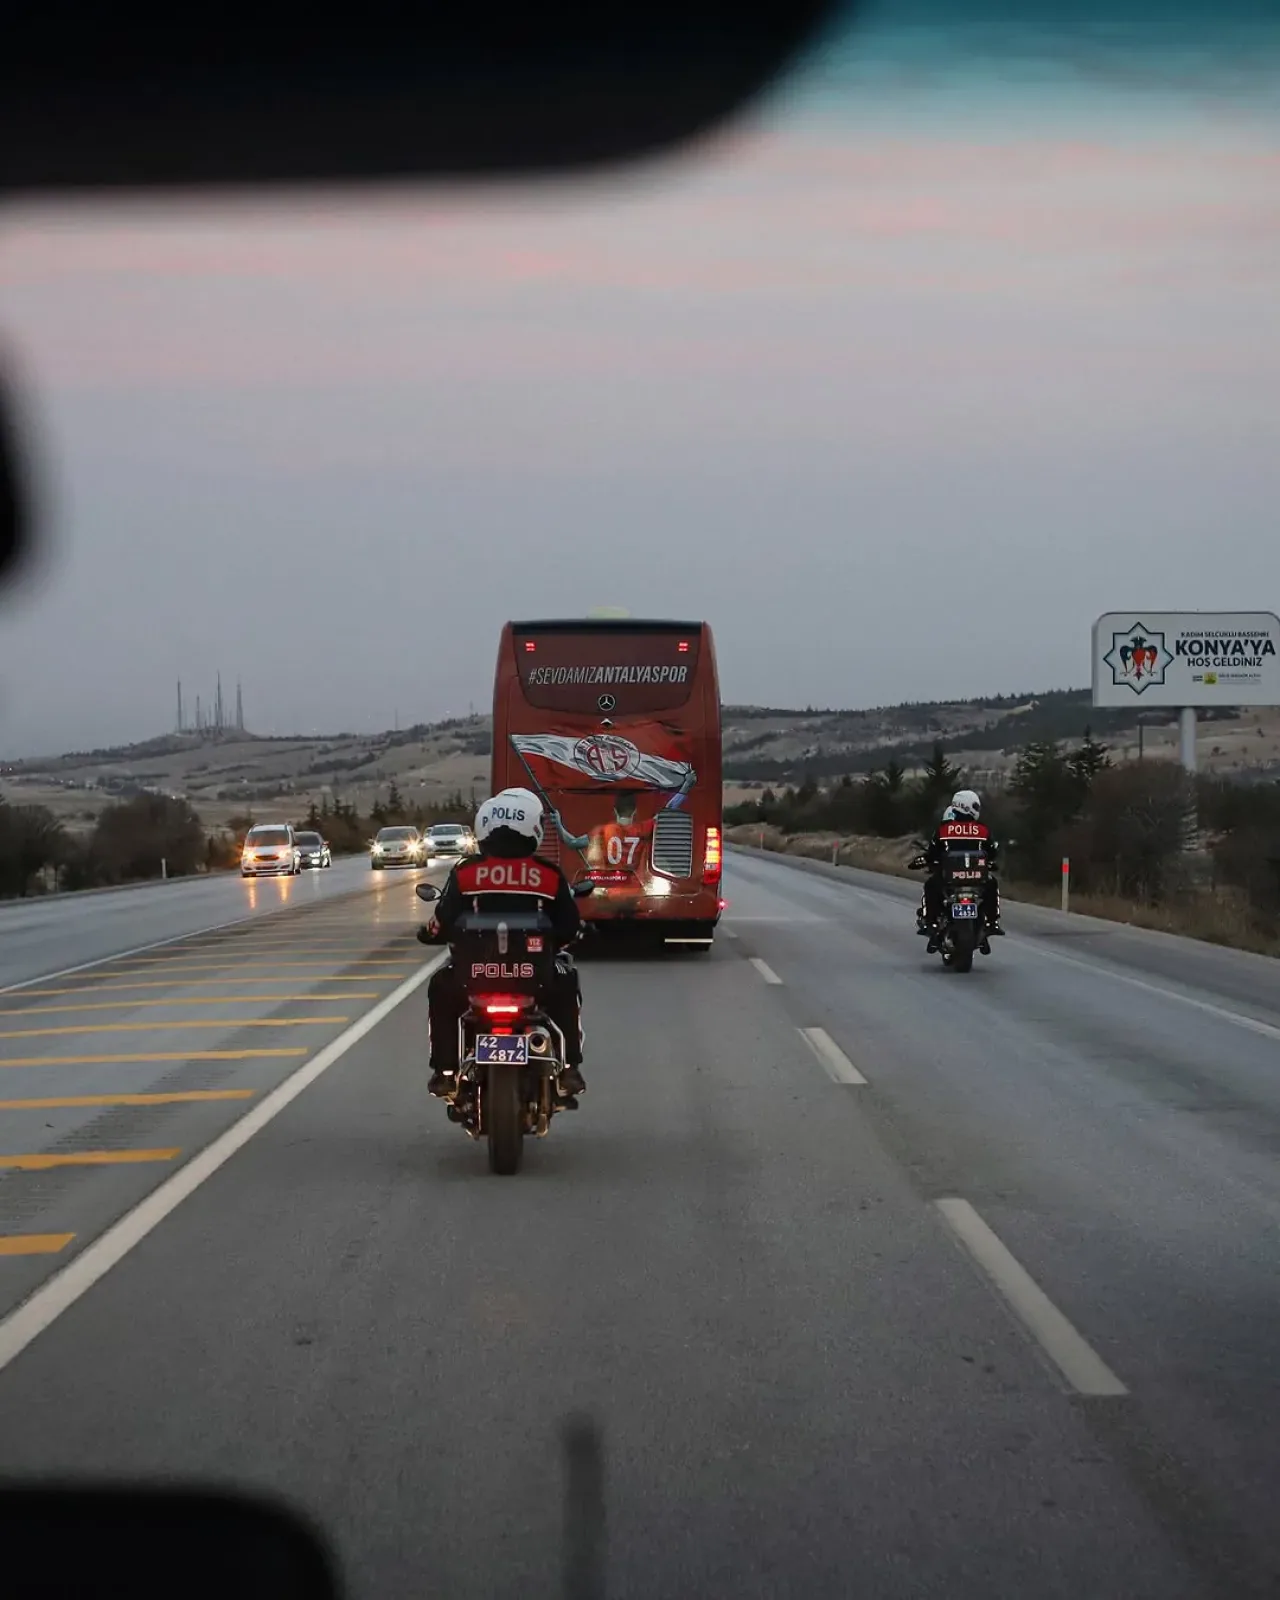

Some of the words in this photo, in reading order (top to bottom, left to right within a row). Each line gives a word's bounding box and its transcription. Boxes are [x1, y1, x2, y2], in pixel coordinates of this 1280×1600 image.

[1175, 639, 1276, 655] KONYA'YA
[1187, 657, 1211, 667] HOŞ
[529, 665, 687, 684] #SEVDAMIZANTALYASPOR
[607, 836, 640, 865] 07
[479, 1036, 498, 1048] 42
[516, 1037, 525, 1048] A
[489, 1050, 525, 1062] 4874
